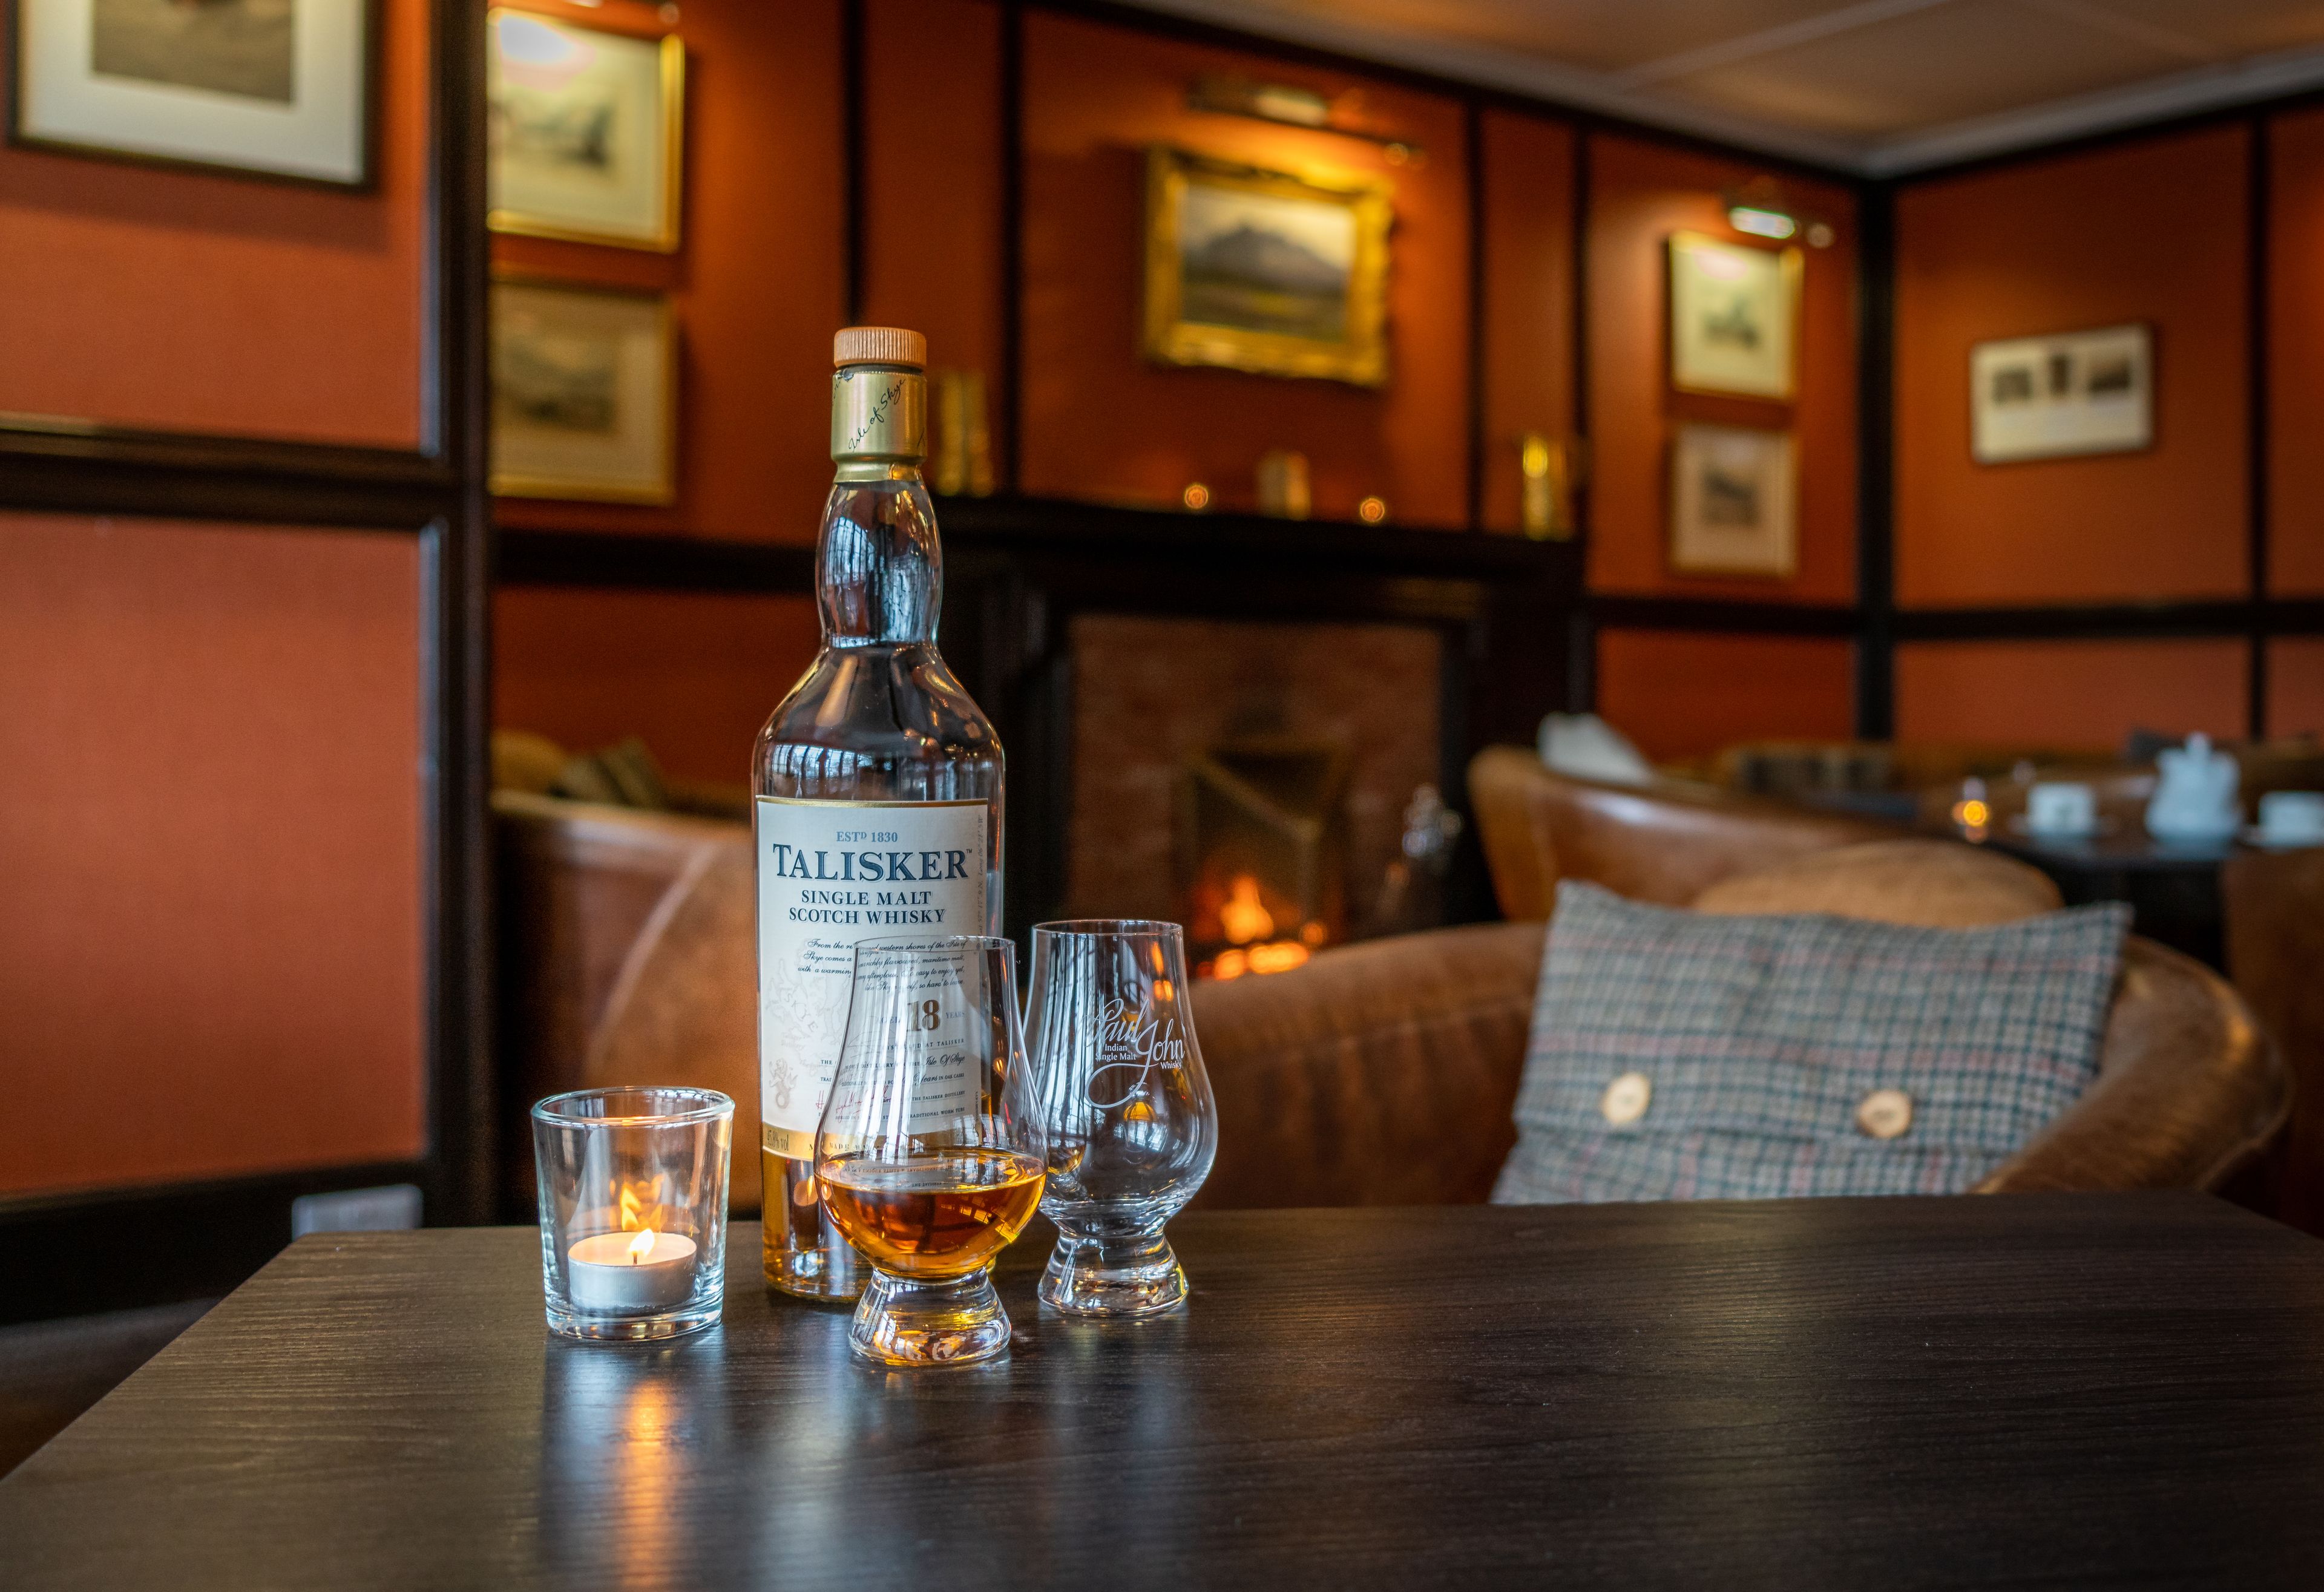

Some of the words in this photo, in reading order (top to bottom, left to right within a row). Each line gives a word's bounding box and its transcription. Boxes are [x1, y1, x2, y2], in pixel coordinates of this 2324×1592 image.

[869, 407, 885, 425] of
[880, 378, 906, 410] Skye
[872, 832, 898, 843] 1830
[773, 843, 969, 882] TALISKER
[801, 889, 870, 906] SINGLE
[876, 891, 931, 906] MALT
[789, 908, 858, 924] SCOTCH
[867, 908, 946, 925] WHISKY
[807, 938, 832, 949] From
[833, 941, 844, 949] the
[927, 942, 937, 952] of
[960, 940, 968, 949] of
[803, 950, 824, 964] Skye
[927, 978, 944, 989] hard
[907, 999, 940, 1031] 18
[1082, 998, 1149, 1047] Paul
[937, 1038, 965, 1046] TALISKER
[1105, 1043, 1128, 1052] Indian
[1160, 1060, 1181, 1069] Whisky
